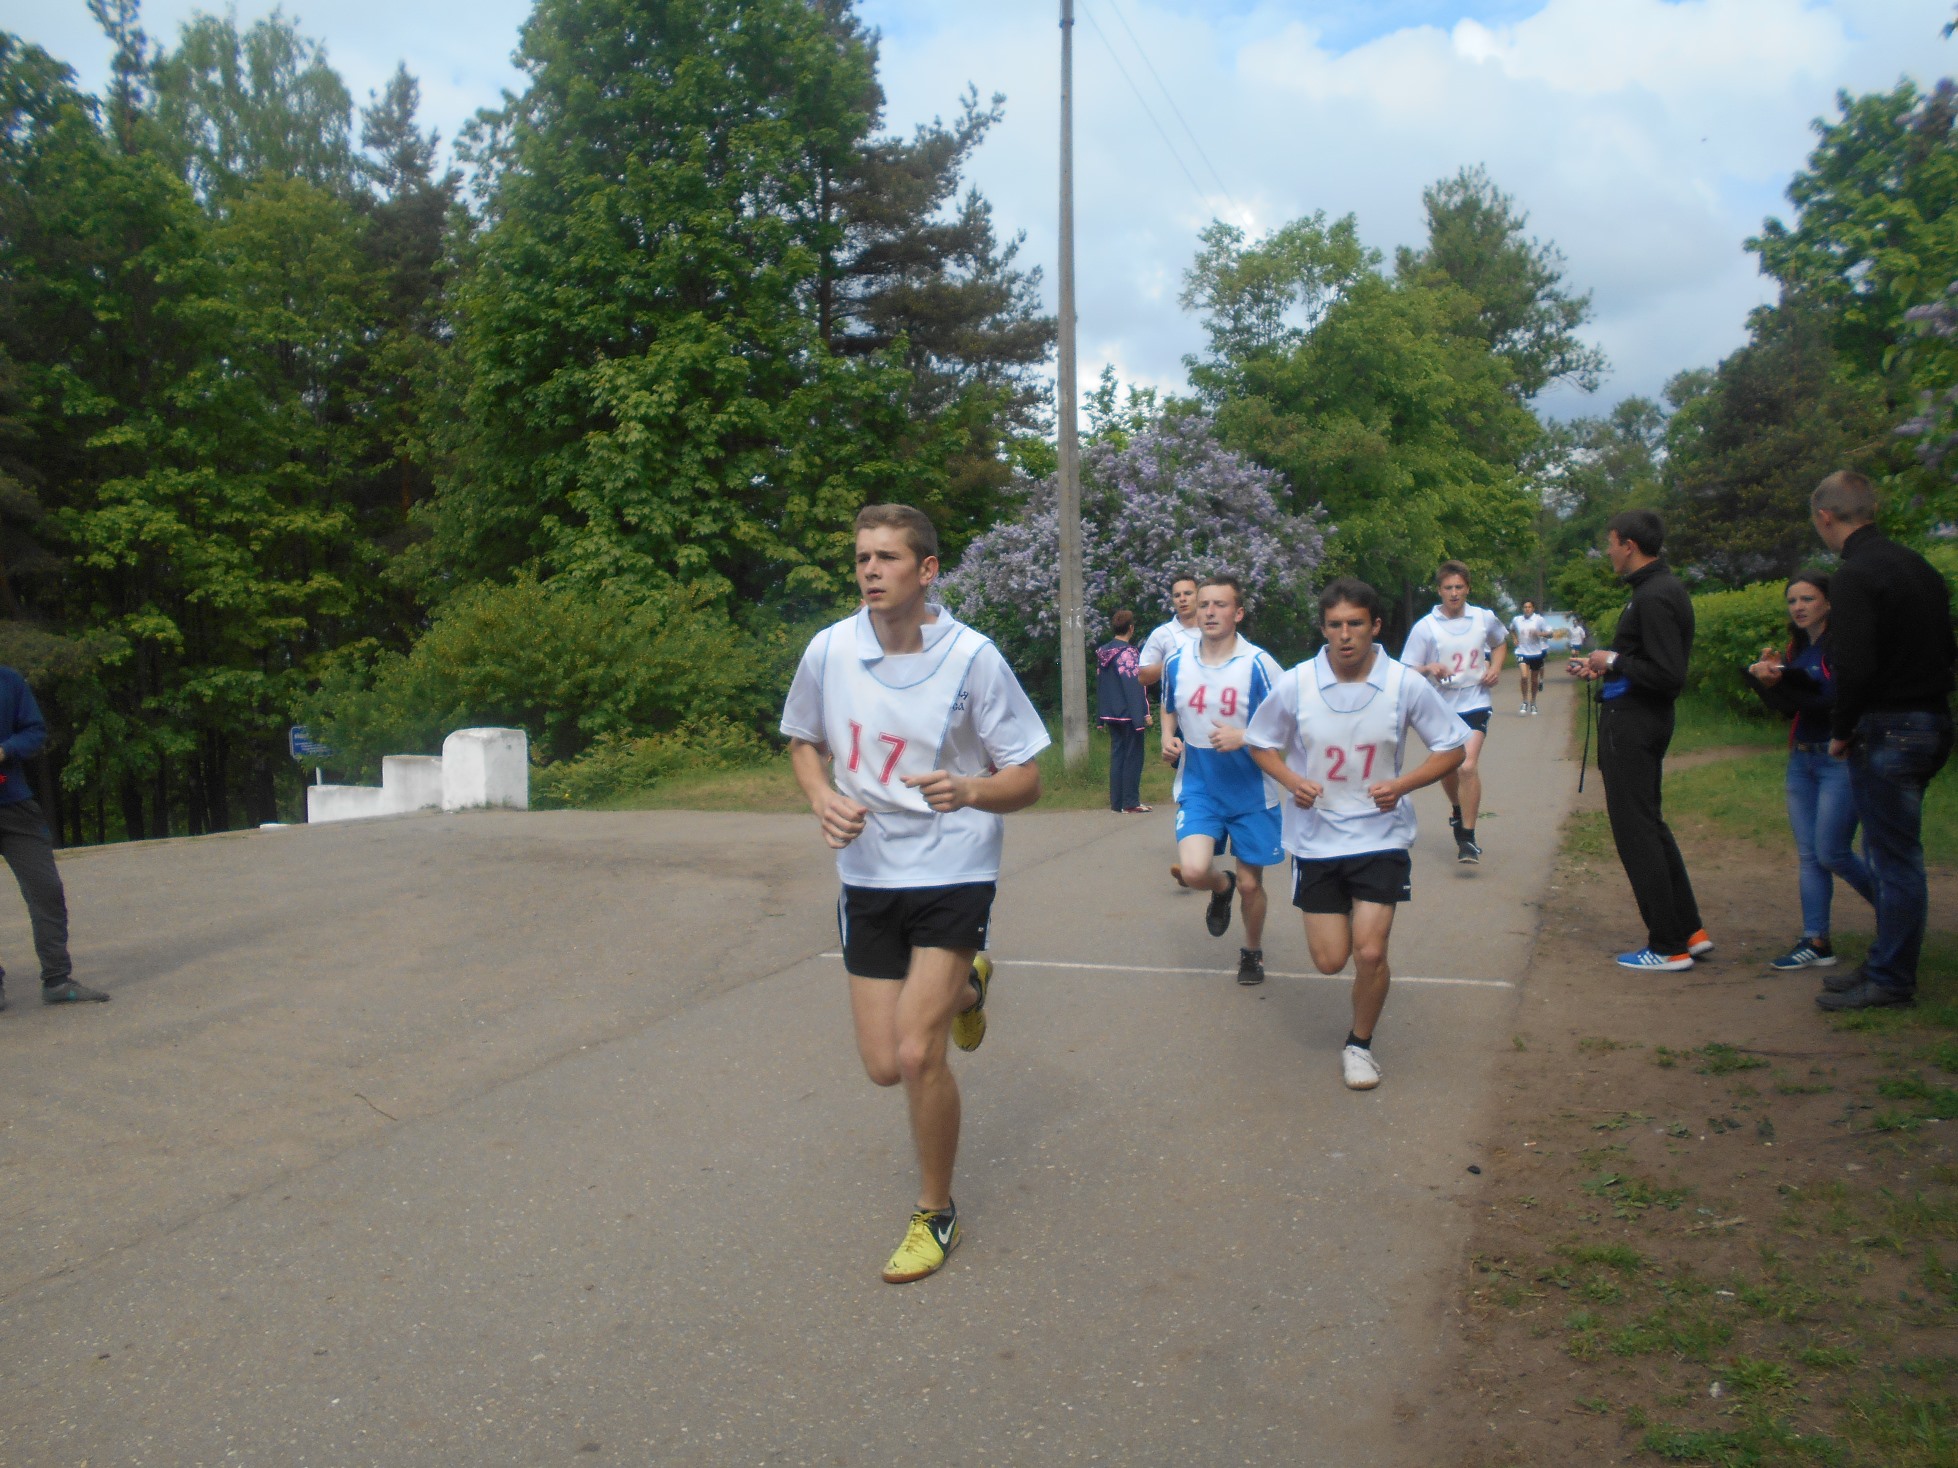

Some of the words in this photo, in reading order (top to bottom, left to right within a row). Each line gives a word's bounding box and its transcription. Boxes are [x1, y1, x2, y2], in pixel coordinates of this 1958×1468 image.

[1452, 649, 1479, 673] 22
[1188, 685, 1238, 717] 49
[847, 720, 908, 785] 17
[1324, 744, 1377, 782] 27
